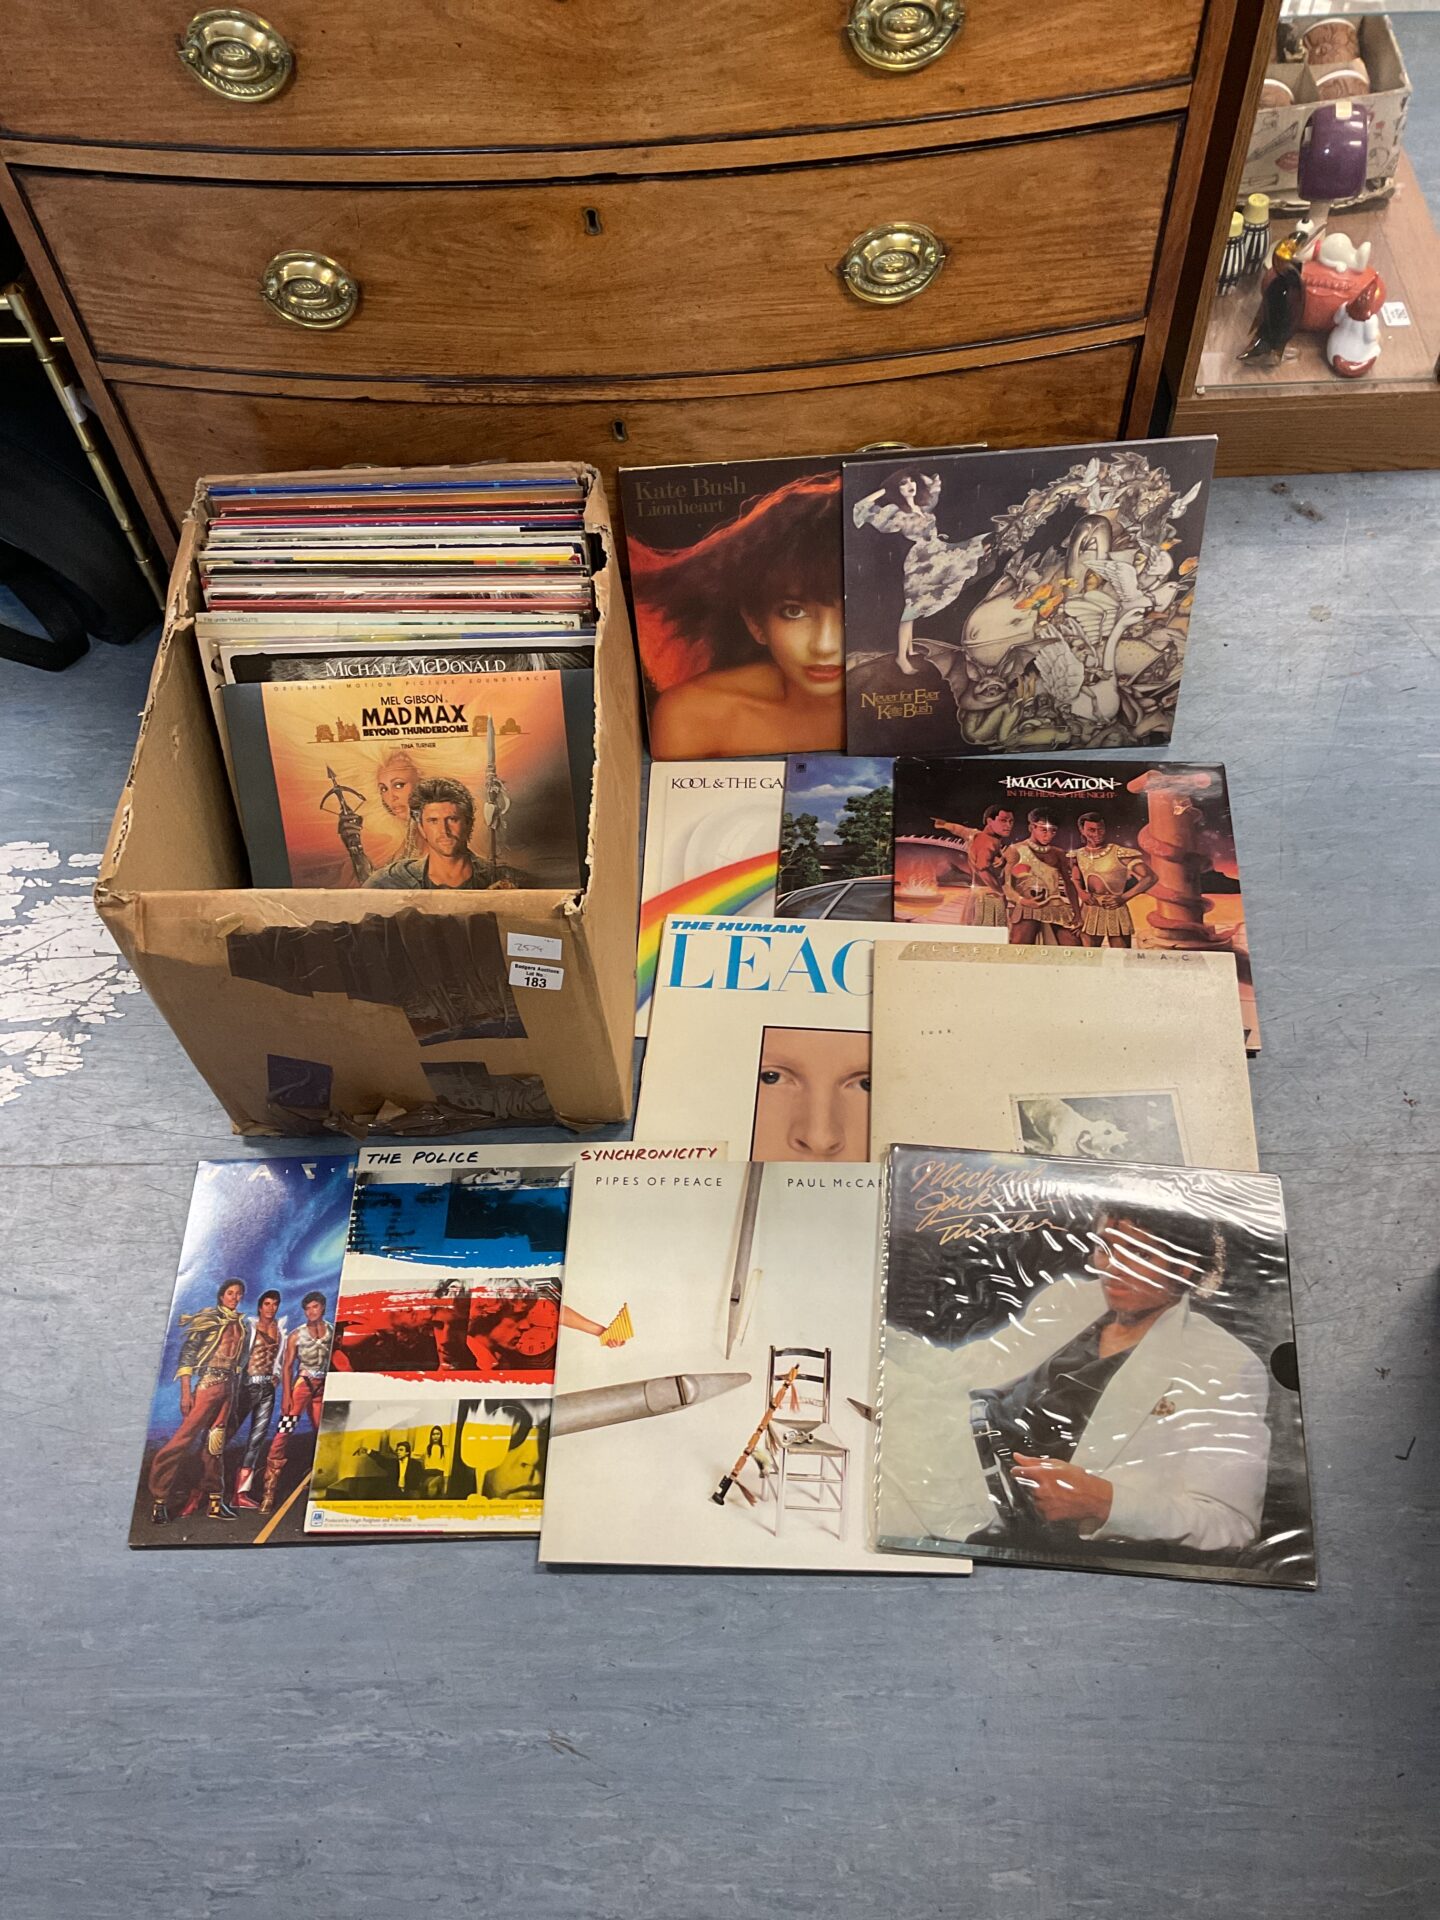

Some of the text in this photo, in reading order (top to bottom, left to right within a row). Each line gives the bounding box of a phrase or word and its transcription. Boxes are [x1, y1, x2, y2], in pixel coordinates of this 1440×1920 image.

[634, 475, 747, 499] Kate Bush
[636, 499, 724, 517] Lionheart
[273, 675, 548, 692] ORIGINAL MOTION PICTURE SOUNDTRACK
[380, 694, 444, 706] MEL GIBSON
[861, 692, 899, 708] Never
[914, 688, 940, 704] Ever
[362, 703, 468, 727] MAD MAX
[878, 702, 933, 720] Kate Bush
[363, 724, 470, 737] BEYOND THUNDERDOME
[671, 777, 710, 789] KOOL
[712, 778, 724, 789] &
[725, 777, 757, 789] THE
[1006, 775, 1115, 791] IMAGINATION
[1007, 789, 1017, 797] IN
[1019, 789, 1035, 798] THE
[670, 920, 807, 934] THE HUMAN
[911, 944, 1190, 961] FLEETWOOD MAC
[514, 963, 536, 971] Badgers
[524, 976, 547, 988] 183
[367, 1151, 479, 1165] THE POLICE
[579, 1146, 719, 1162] SYNCHRONICITY
[595, 1176, 723, 1187] PIPES OF PEACE
[787, 1178, 826, 1188] PAUL
[911, 1160, 1047, 1192] Michael
